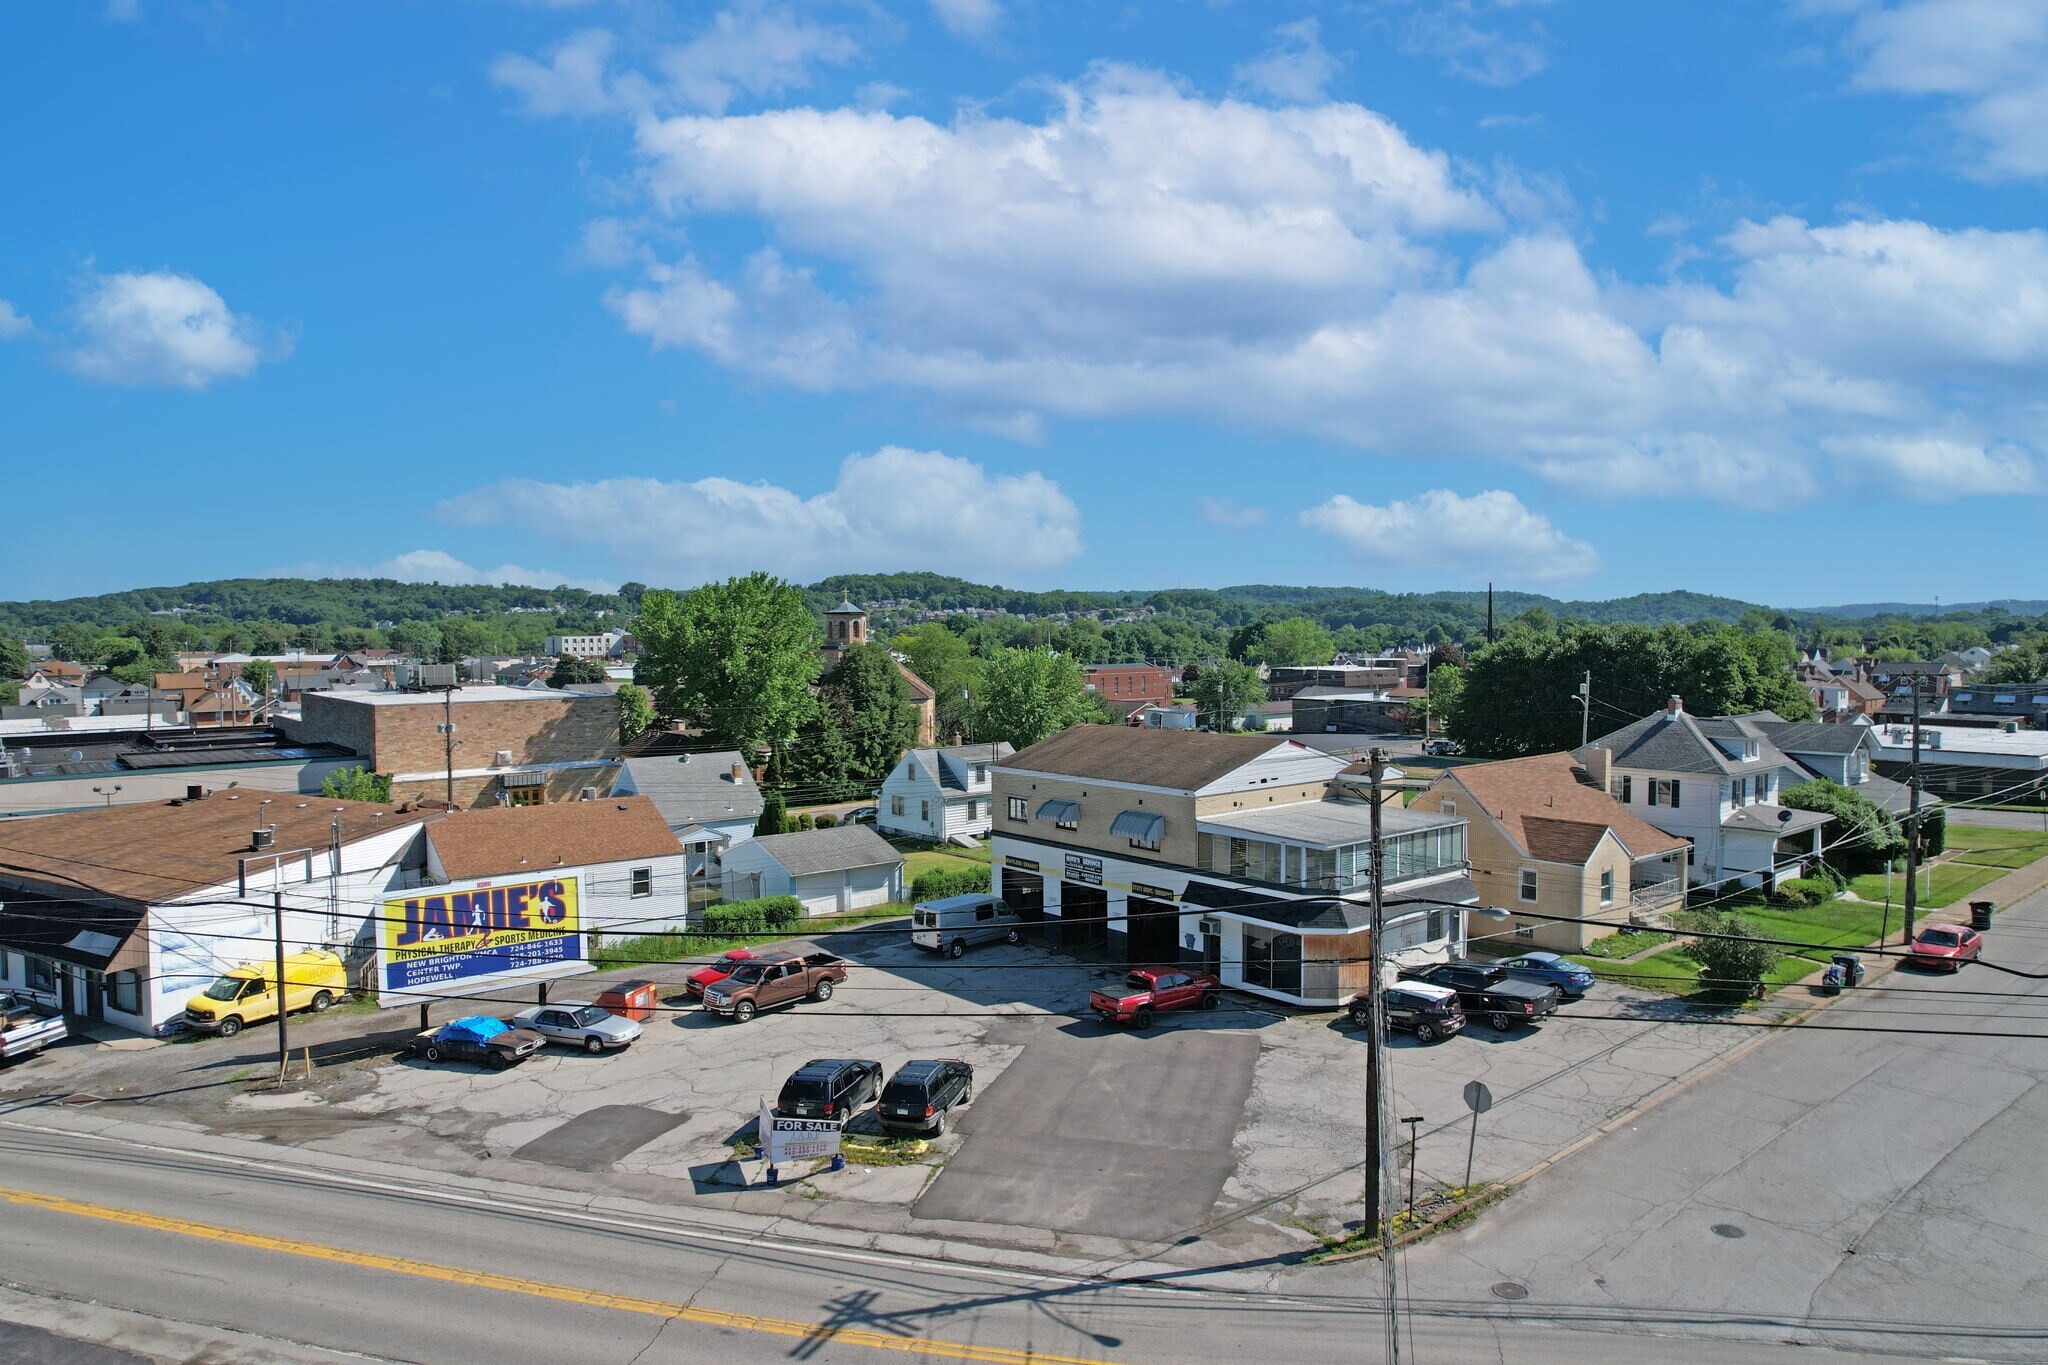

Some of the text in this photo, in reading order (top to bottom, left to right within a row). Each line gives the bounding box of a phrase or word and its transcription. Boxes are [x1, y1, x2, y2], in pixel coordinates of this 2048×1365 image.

[397, 880, 566, 946] JAMIE'S
[395, 945, 438, 961] PHYSICAL
[439, 940, 476, 955] THERAPY
[495, 932, 526, 946] SPORTS
[510, 938, 563, 953] 724-846-1633
[406, 949, 498, 969] NEW BRIGHTON YMCA
[406, 962, 463, 977] CENTER TWP.
[407, 973, 454, 985] HOPEWELL
[776, 1120, 837, 1132] FOR SALE
